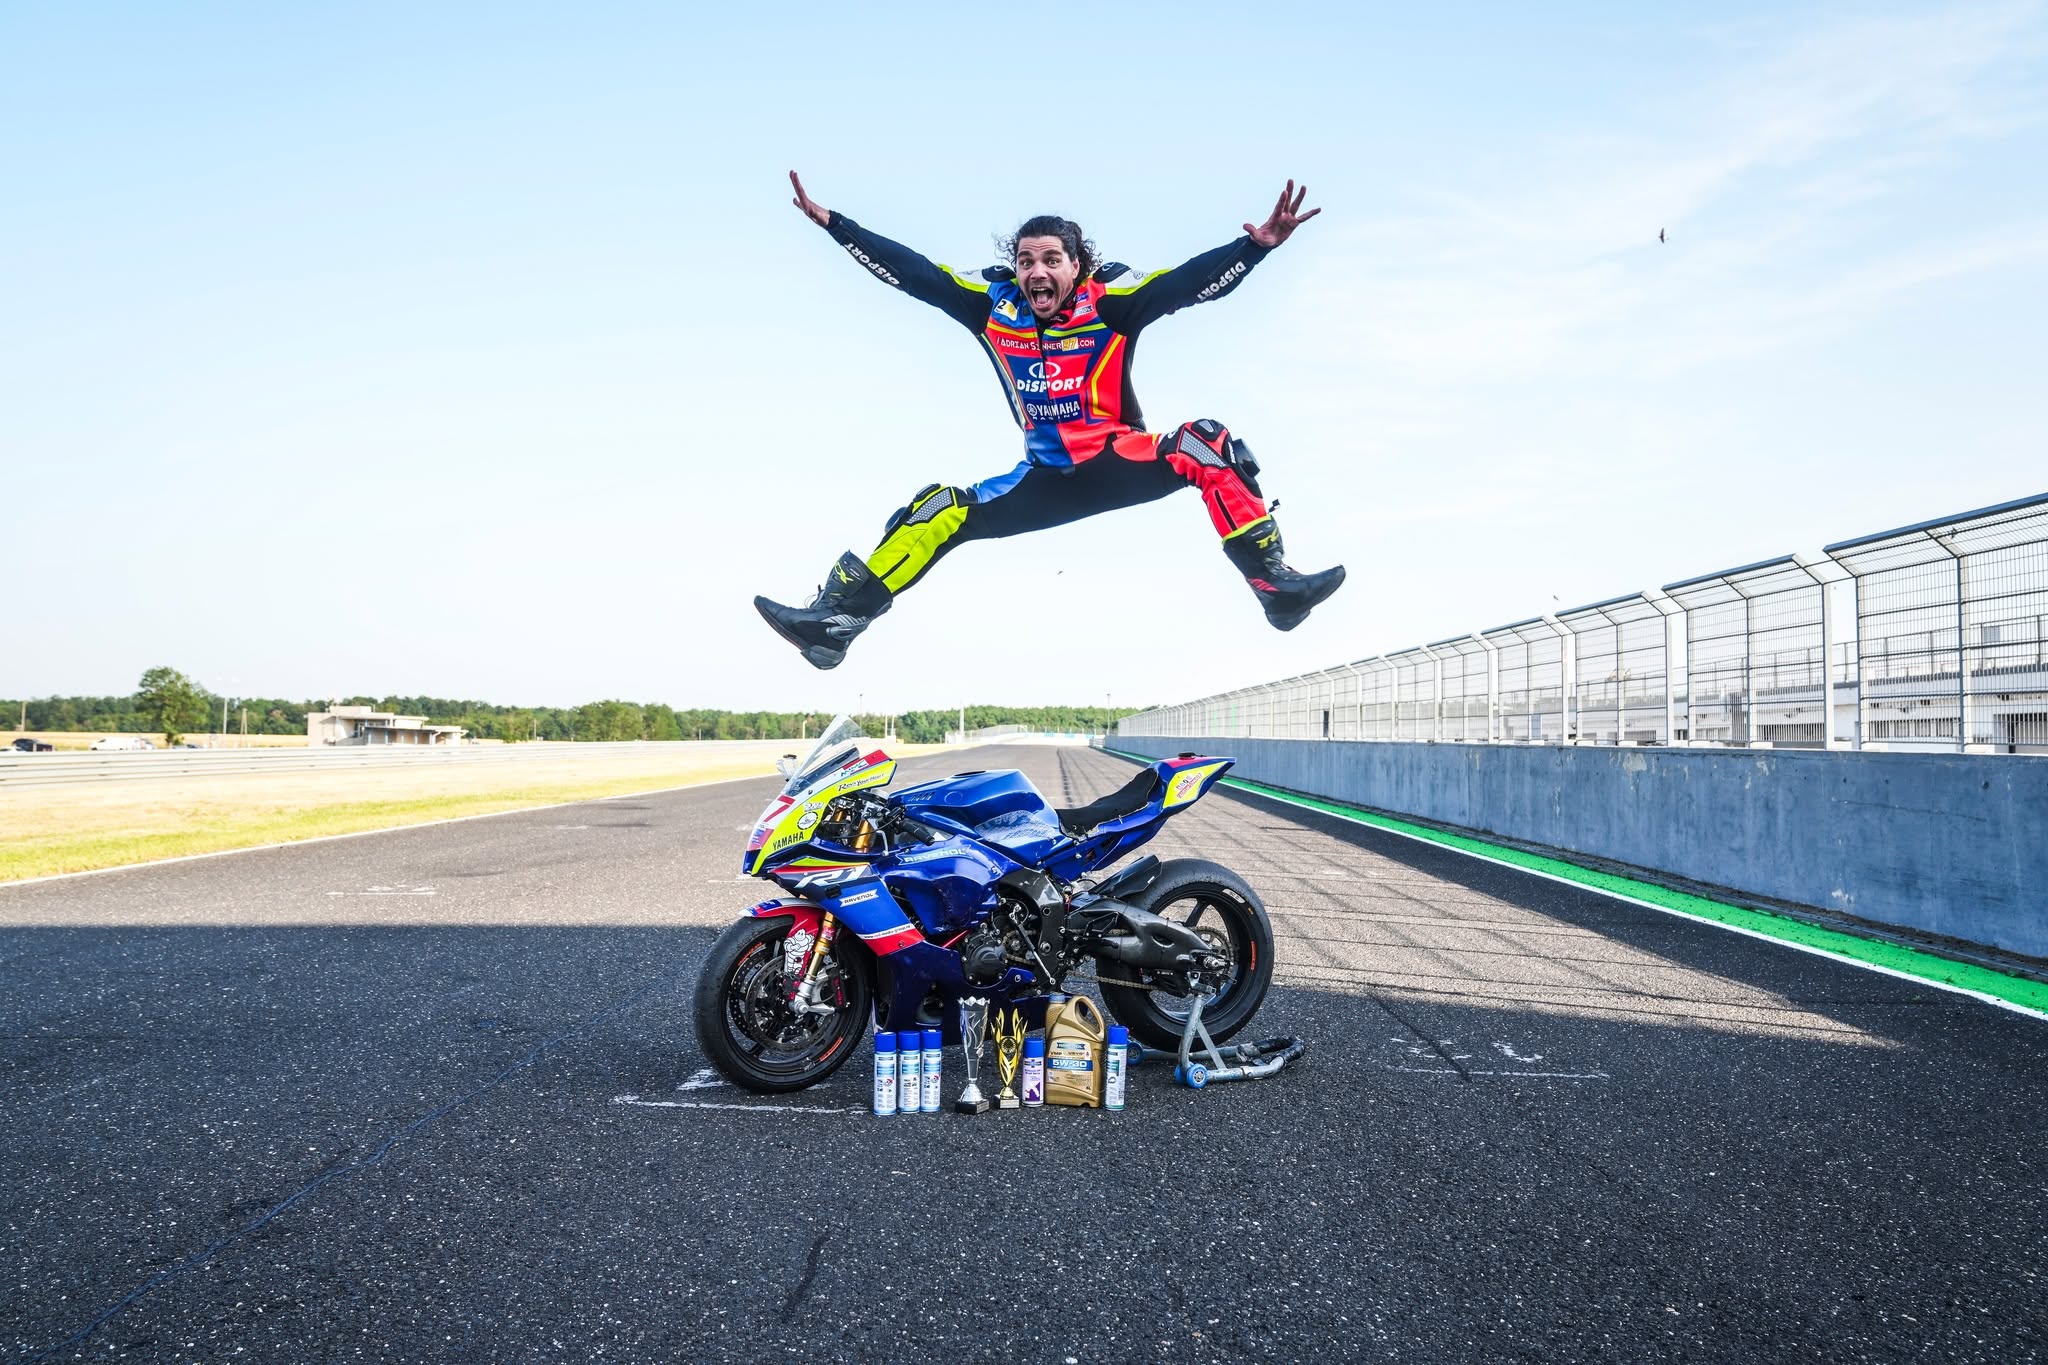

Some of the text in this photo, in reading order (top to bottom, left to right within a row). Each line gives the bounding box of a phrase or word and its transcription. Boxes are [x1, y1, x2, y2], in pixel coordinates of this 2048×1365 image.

[1036, 401, 1080, 416] YAMAHA
[763, 795, 796, 823] 7
[772, 831, 804, 851] YAMAHA
[844, 892, 874, 904] RAVENOL
[1052, 1059, 1088, 1068] 5W-30
